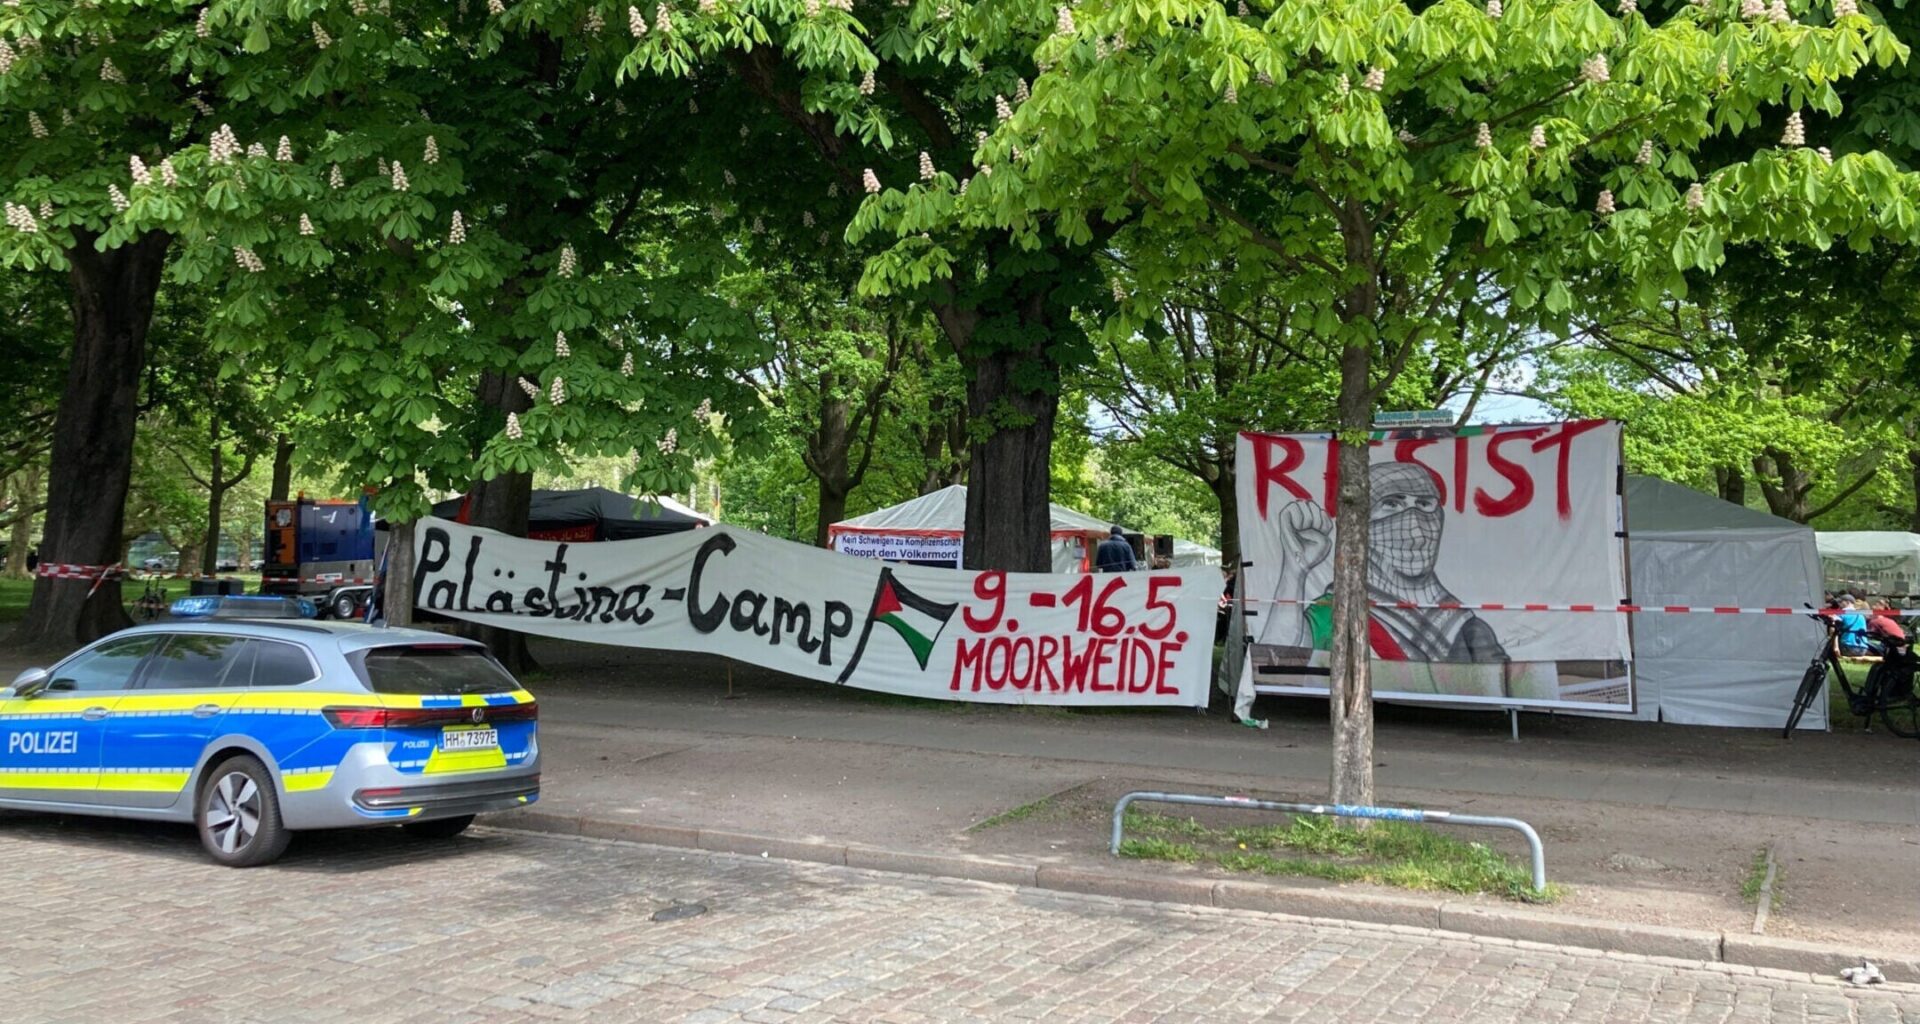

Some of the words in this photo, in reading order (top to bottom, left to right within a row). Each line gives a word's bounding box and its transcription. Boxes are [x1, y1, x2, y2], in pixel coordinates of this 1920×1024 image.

[842, 535, 857, 545] Kein
[859, 536, 894, 547] Schweigen
[844, 547, 876, 558] Stoppt
[878, 548, 897, 559] den
[413, 527, 853, 666] Palästina-Camp
[950, 635, 1183, 694] MOORWEIDE
[9, 731, 78, 754] POLIZEI
[403, 740, 429, 749] POLIZEI
[445, 732, 459, 748] HH
[467, 730, 497, 746] 7397E
